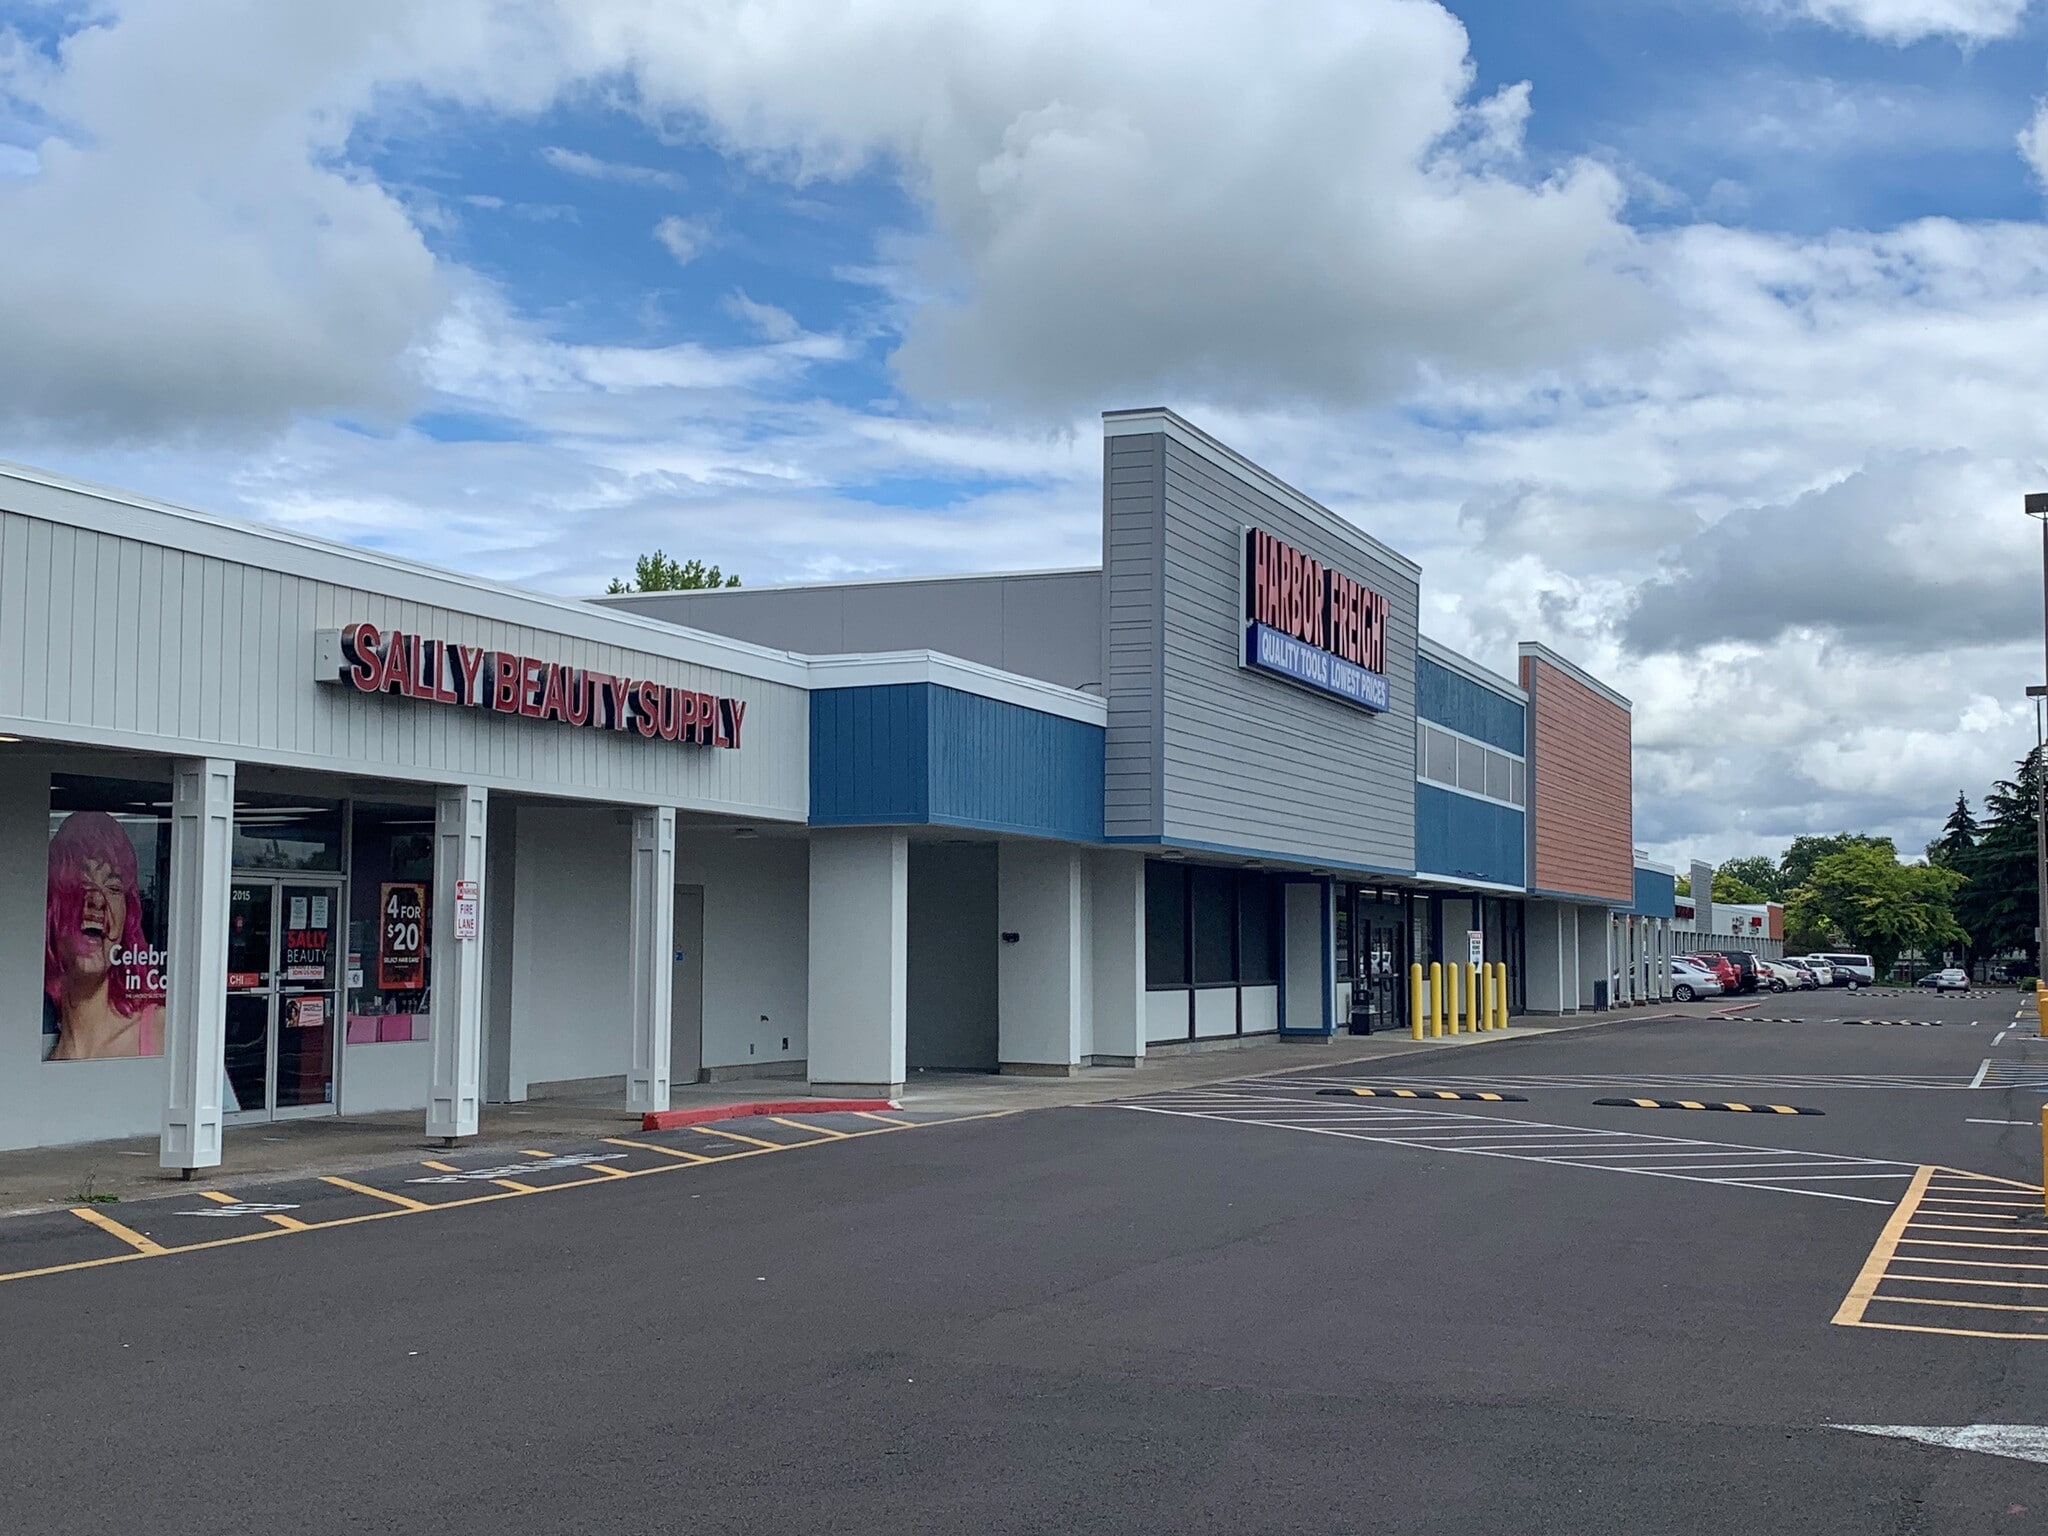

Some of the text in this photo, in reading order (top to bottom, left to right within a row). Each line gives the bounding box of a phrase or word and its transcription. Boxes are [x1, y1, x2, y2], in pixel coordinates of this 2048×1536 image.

[1254, 528, 1391, 675] HARBOR FREIGHT
[1261, 631, 1386, 707] QUALITY TOOLS LOWEST PRICES
[345, 623, 747, 749] SALLY BEAUTY SUPPLY
[232, 890, 251, 901] 2015
[387, 894, 421, 919] 4 FOR
[460, 903, 473, 915] FIRE
[458, 918, 474, 930] LANE
[287, 930, 328, 948] SALLY
[387, 922, 419, 951] $20
[109, 943, 168, 966] Celebr
[287, 949, 328, 963] BEAUTY
[125, 969, 141, 990] in
[229, 975, 244, 986] CHI
